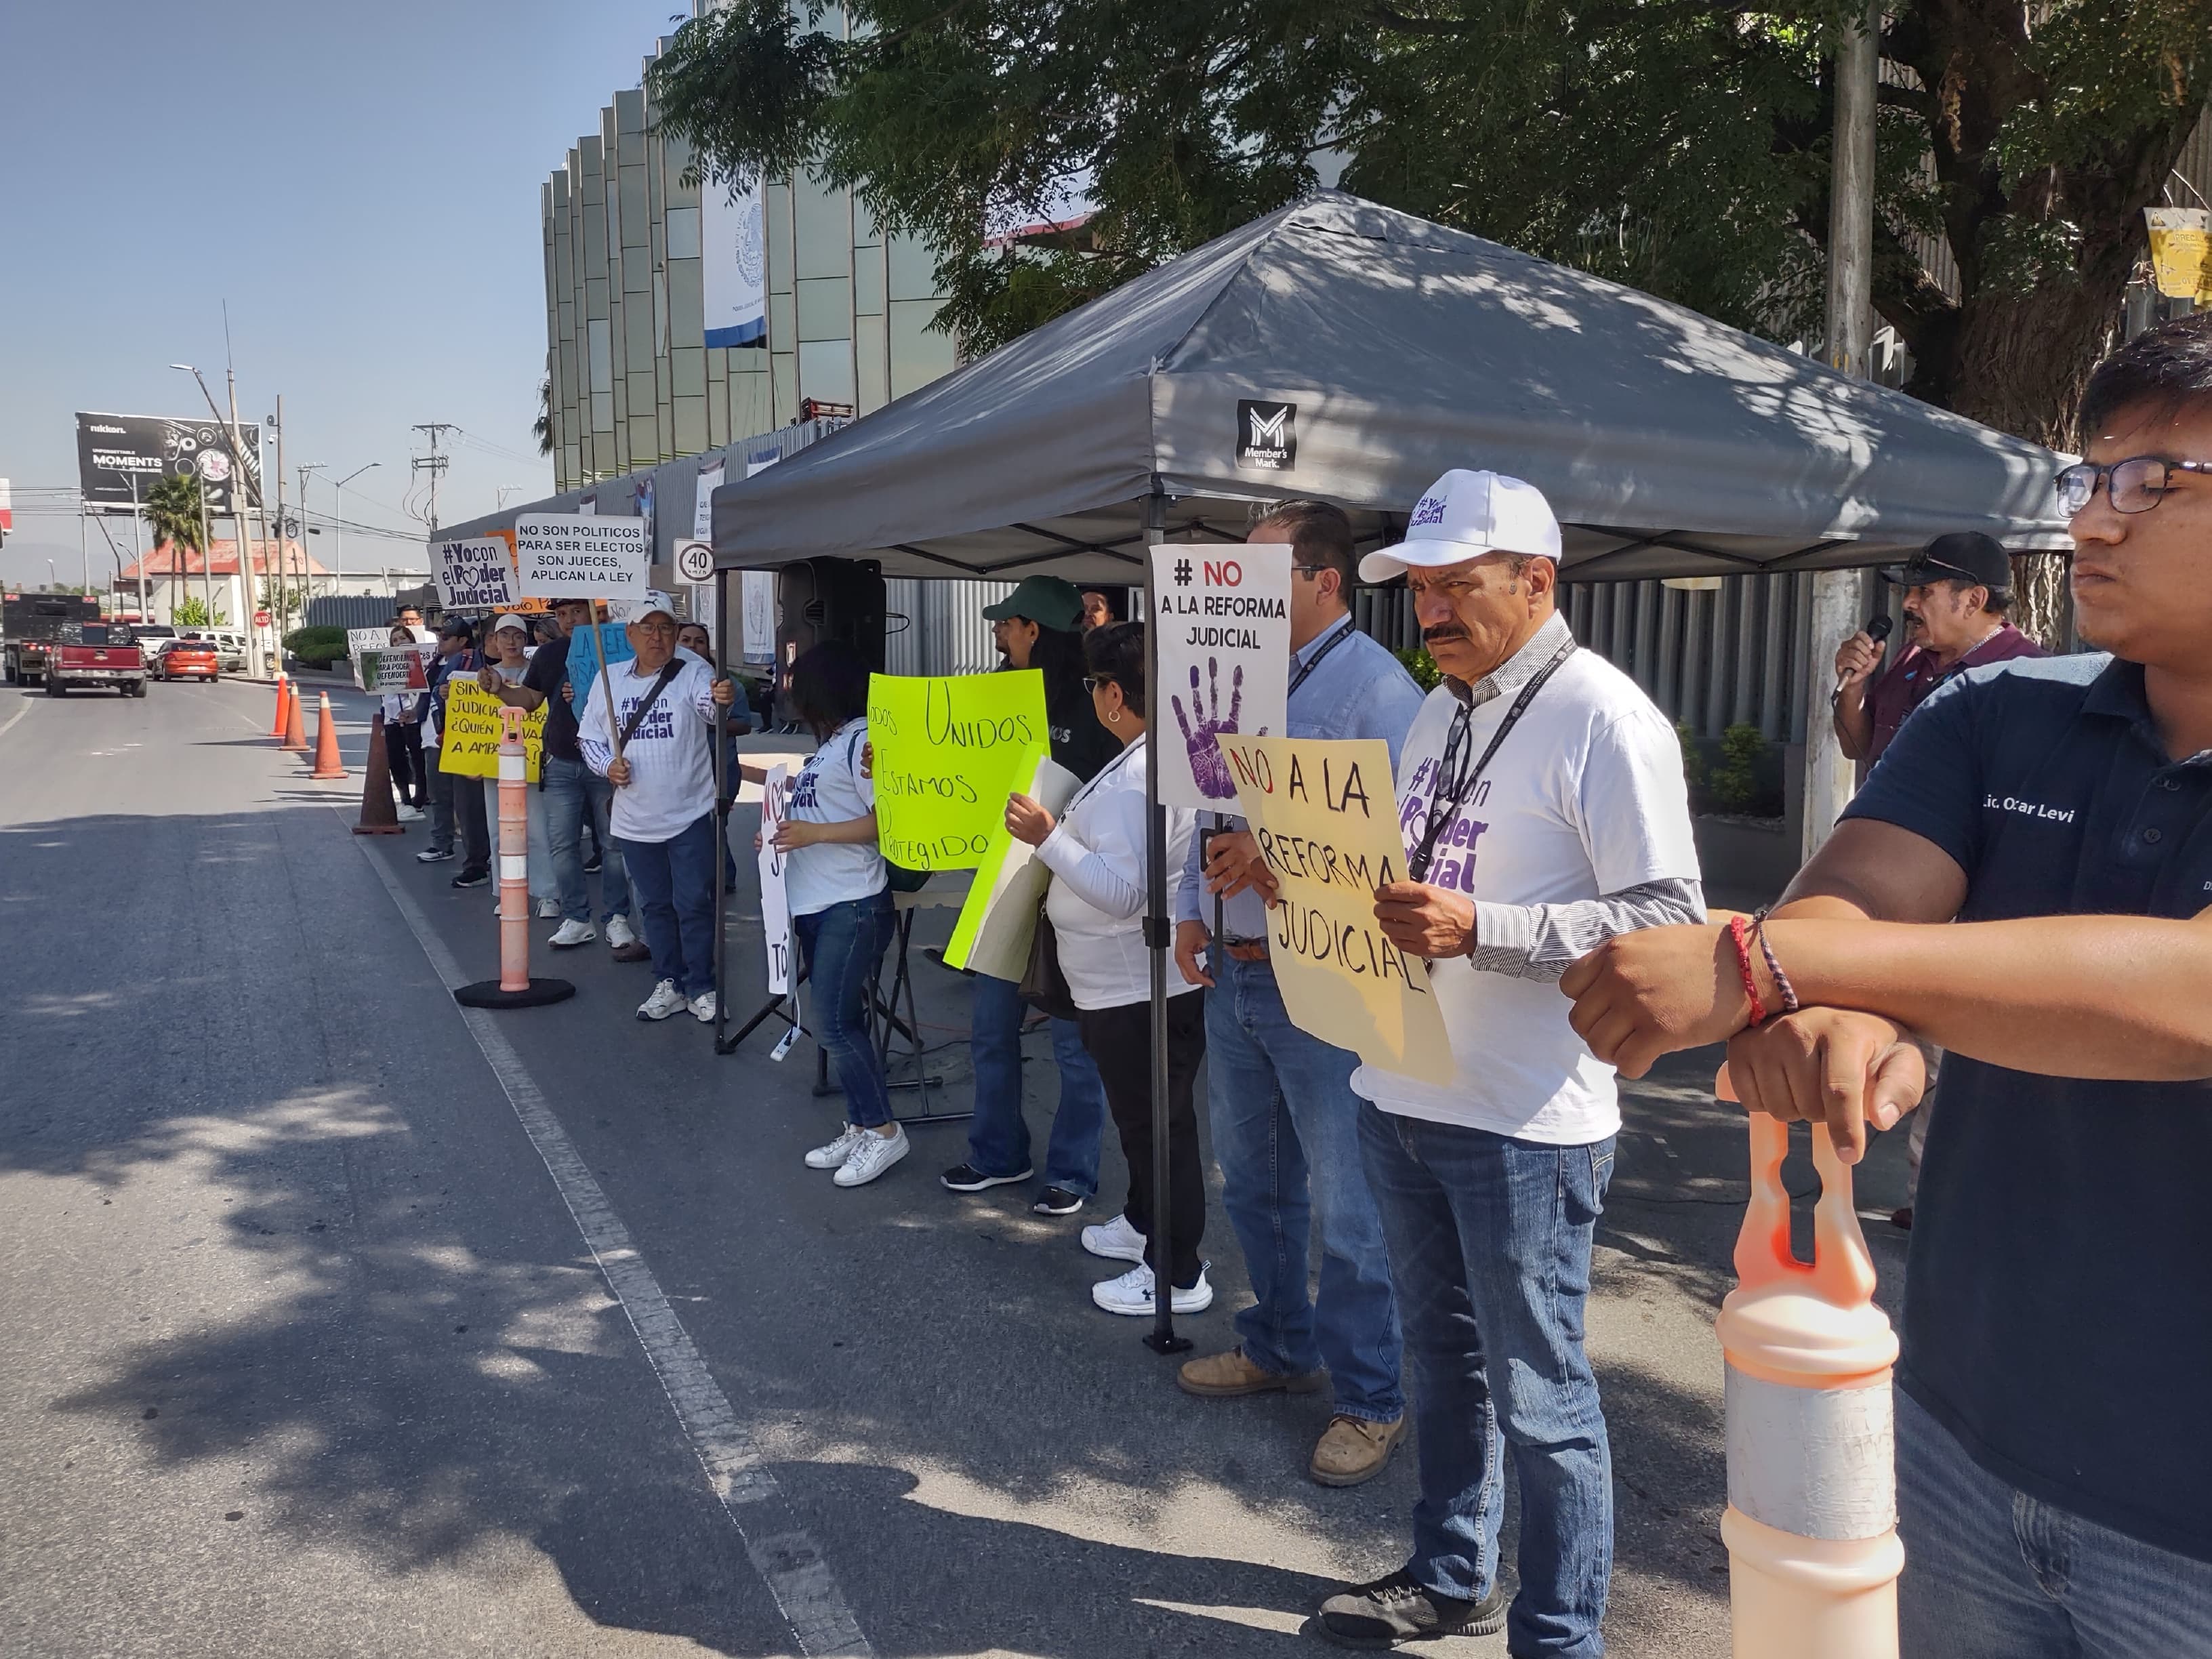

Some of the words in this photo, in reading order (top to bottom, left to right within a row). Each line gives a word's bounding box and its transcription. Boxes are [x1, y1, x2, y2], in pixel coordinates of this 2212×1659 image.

[93, 455, 163, 467] MOMENTS
[1244, 447, 1288, 459] Member's
[1254, 457, 1279, 468] Mark.
[520, 525, 538, 535] NO
[543, 525, 569, 536] SON
[573, 527, 640, 538] POLITICOS
[518, 540, 552, 551] PARA
[556, 541, 581, 552] SER
[585, 542, 643, 553] ELECTOS
[537, 555, 564, 566] SON
[568, 556, 621, 569] JUECES,
[689, 552, 707, 569] 40
[531, 570, 586, 581] APLICAN
[590, 571, 606, 581] LA
[610, 572, 634, 582] LEY
[1174, 558, 1193, 586] #
[1204, 560, 1242, 587] NO
[449, 583, 510, 606] Judicial
[1161, 595, 1172, 614] A
[1178, 596, 1199, 615] LA
[1204, 596, 1286, 619] REFORMA
[255, 615, 270, 623] ALTO
[350, 630, 367, 642] NO
[1186, 626, 1261, 649] JUDICIAL
[455, 681, 479, 696] SIN
[926, 680, 1032, 748] UNIDOS
[451, 718, 494, 734] ¿QUIÉN
[451, 741, 463, 753] A
[881, 749, 977, 803] ESTAMOS
[1229, 747, 1273, 794] NO
[1289, 754, 1309, 804] A
[1324, 758, 1370, 819] LA
[2037, 804, 2074, 823] Levi
[1258, 827, 1395, 896] REFORMA
[1277, 899, 1426, 994] JUDICIAL
